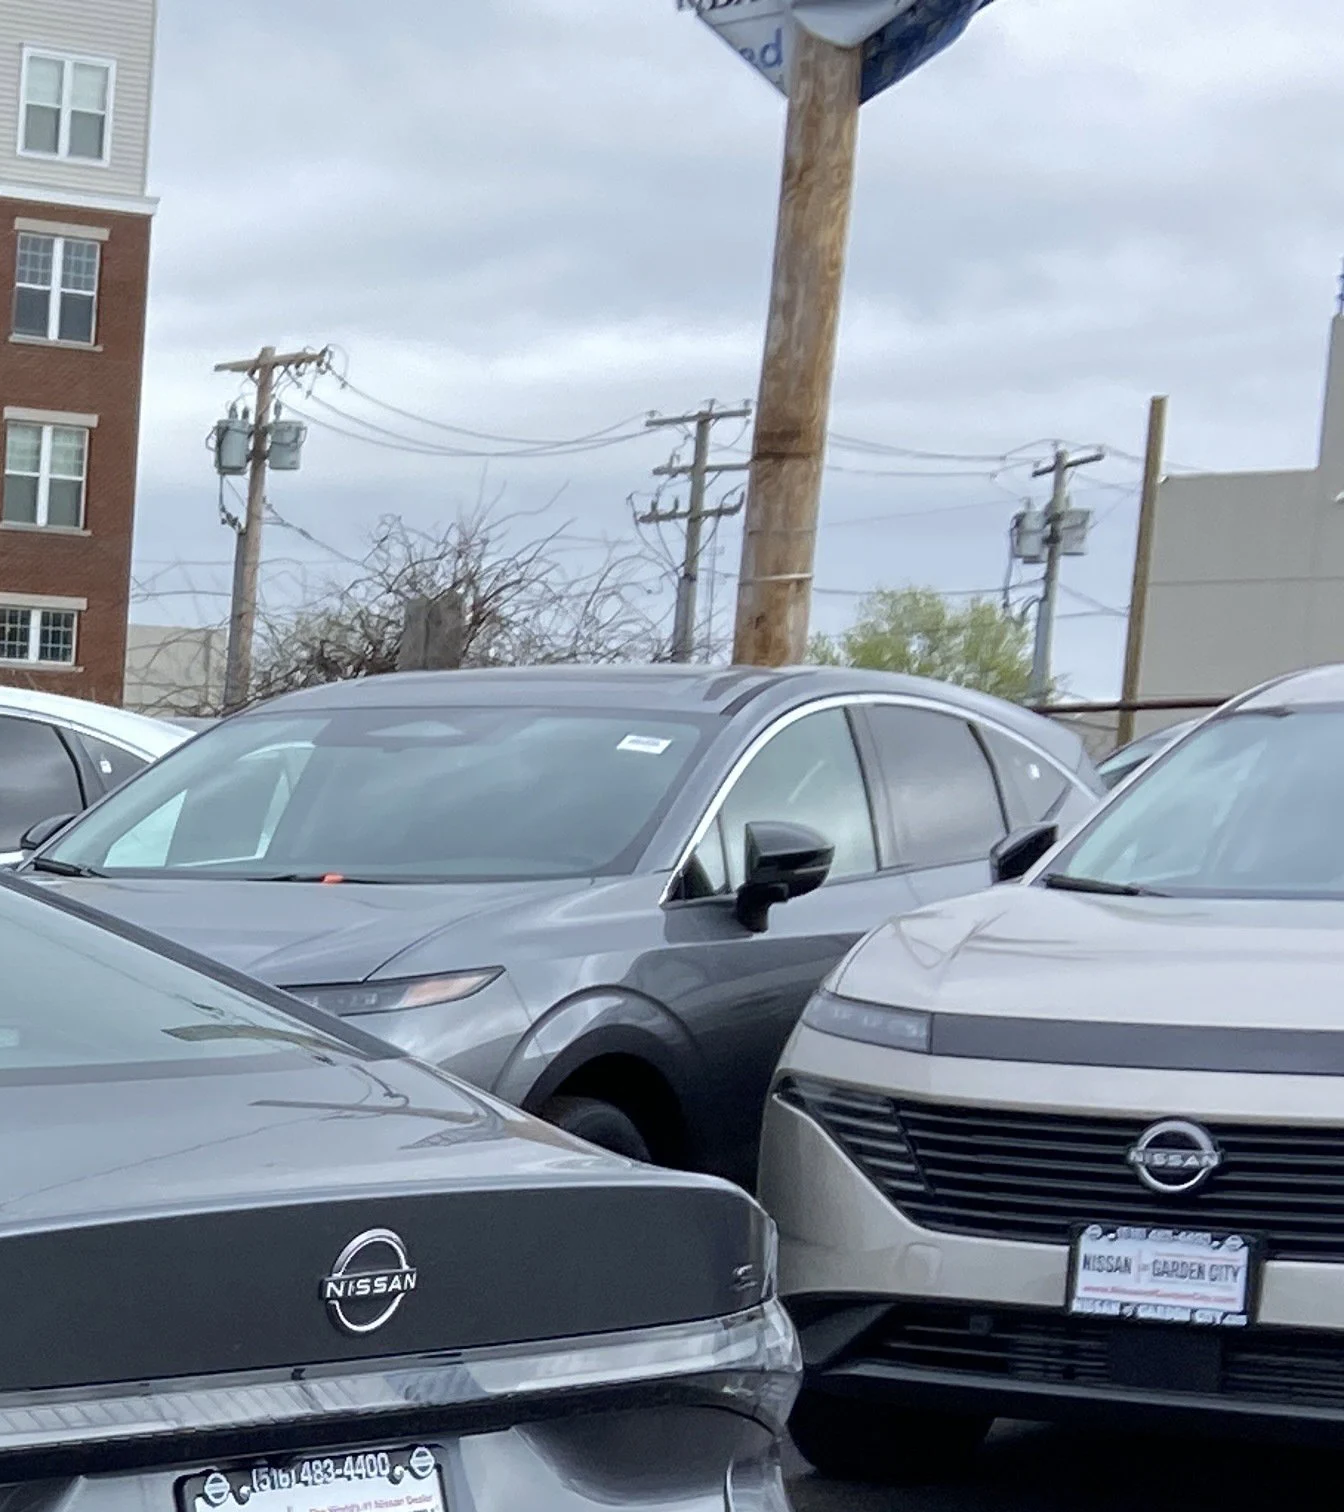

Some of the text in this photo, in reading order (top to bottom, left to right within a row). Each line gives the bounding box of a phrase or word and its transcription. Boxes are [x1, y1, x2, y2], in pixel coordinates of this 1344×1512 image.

[1129, 1150, 1221, 1169] NISSAN
[1082, 1253, 1132, 1274] NISSAN
[1152, 1258, 1206, 1281] GARDEN
[1208, 1264, 1241, 1283] CITY
[325, 1272, 418, 1298] NISSAN
[251, 1452, 391, 1493] (516) 483-4400
